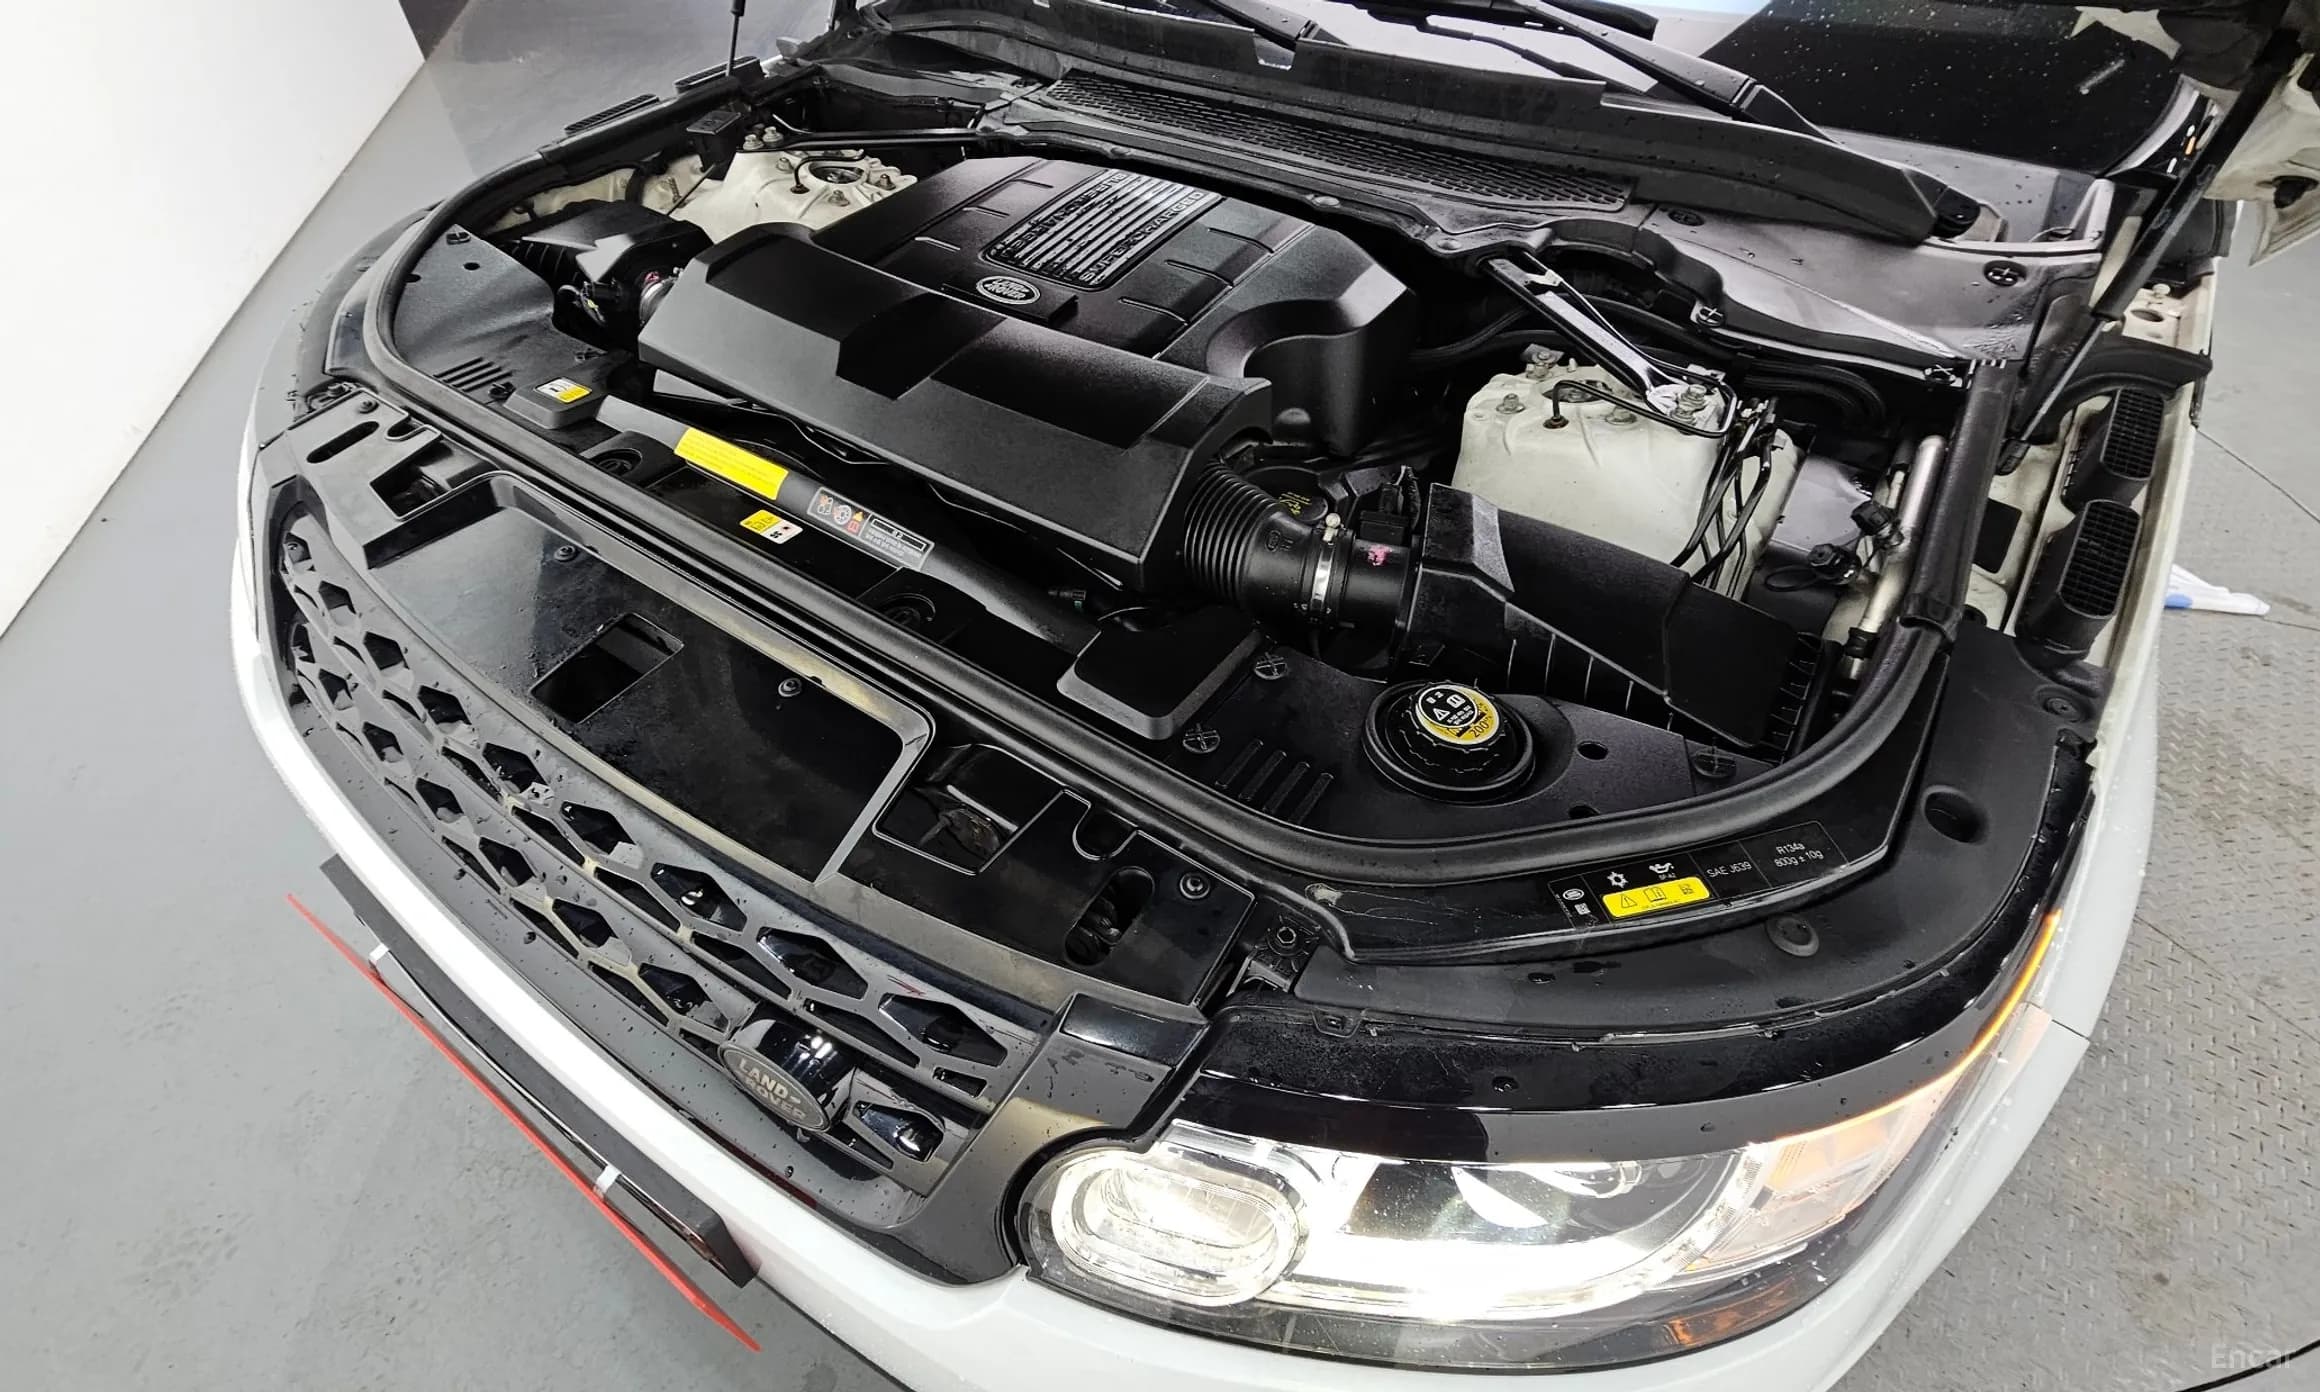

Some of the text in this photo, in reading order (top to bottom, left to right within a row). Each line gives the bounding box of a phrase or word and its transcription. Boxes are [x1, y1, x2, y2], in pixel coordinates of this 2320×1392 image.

[1079, 190, 1207, 282] SUPERCHARGED
[988, 284, 1026, 300] ROVER
[1775, 842, 1805, 855] R134a
[1773, 856, 1799, 868] 800g
[1805, 850, 1824, 861] 10g
[1706, 861, 1752, 878] SAE J639
[738, 1058, 789, 1100] LAND
[744, 1077, 807, 1121] ROVER
